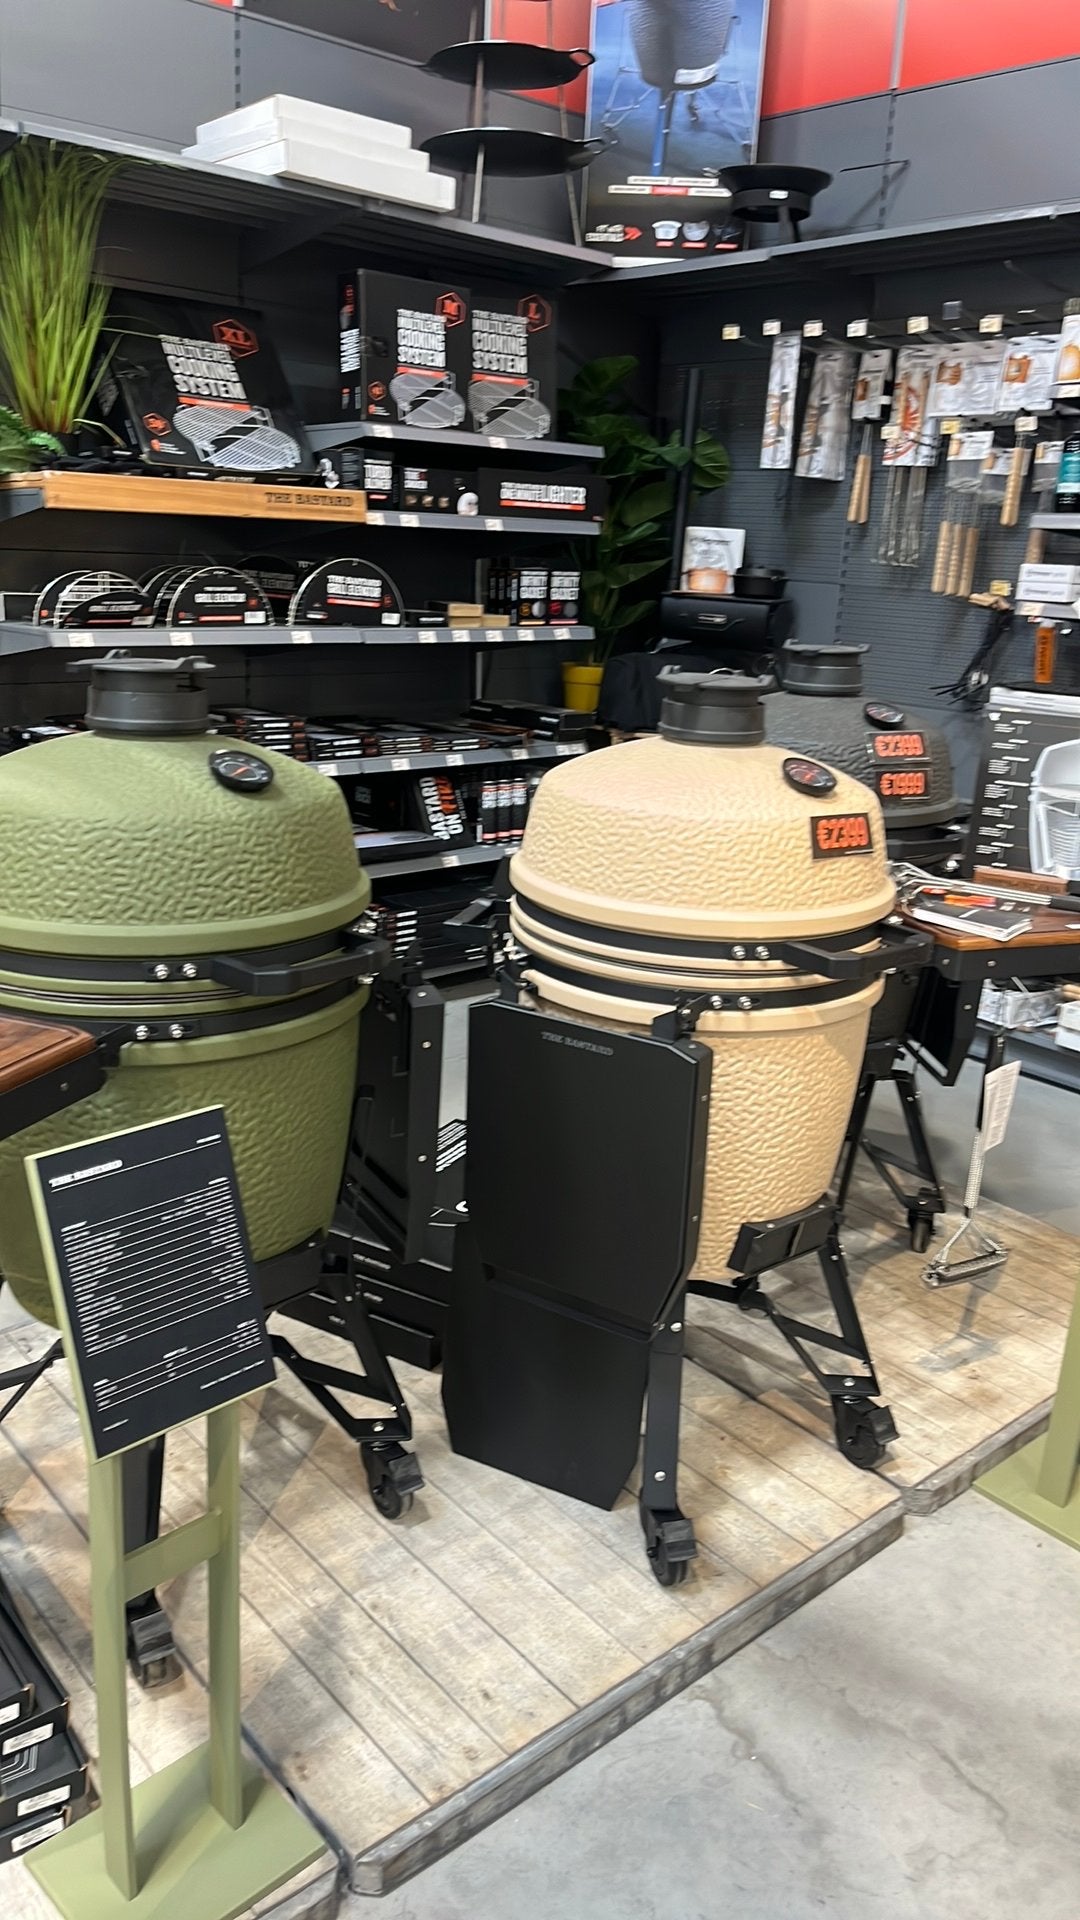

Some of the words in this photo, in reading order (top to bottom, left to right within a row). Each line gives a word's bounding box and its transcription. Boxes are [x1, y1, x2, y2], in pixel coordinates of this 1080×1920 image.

[528, 303, 541, 319] L
[220, 326, 252, 346] XL
[472, 318, 528, 337] MULTILEVEL
[397, 329, 446, 352] COOKING
[472, 331, 528, 356] COOKING
[397, 346, 446, 368] SYSTEM
[472, 350, 528, 375] SYSTEM
[166, 355, 241, 382] COOKING
[173, 373, 248, 400] SYSTEM
[264, 491, 292, 504] THE
[294, 493, 353, 507] BASTARD
[445, 813, 464, 835] ON
[541, 1030, 565, 1044] THE
[563, 1036, 614, 1056] BASTARD
